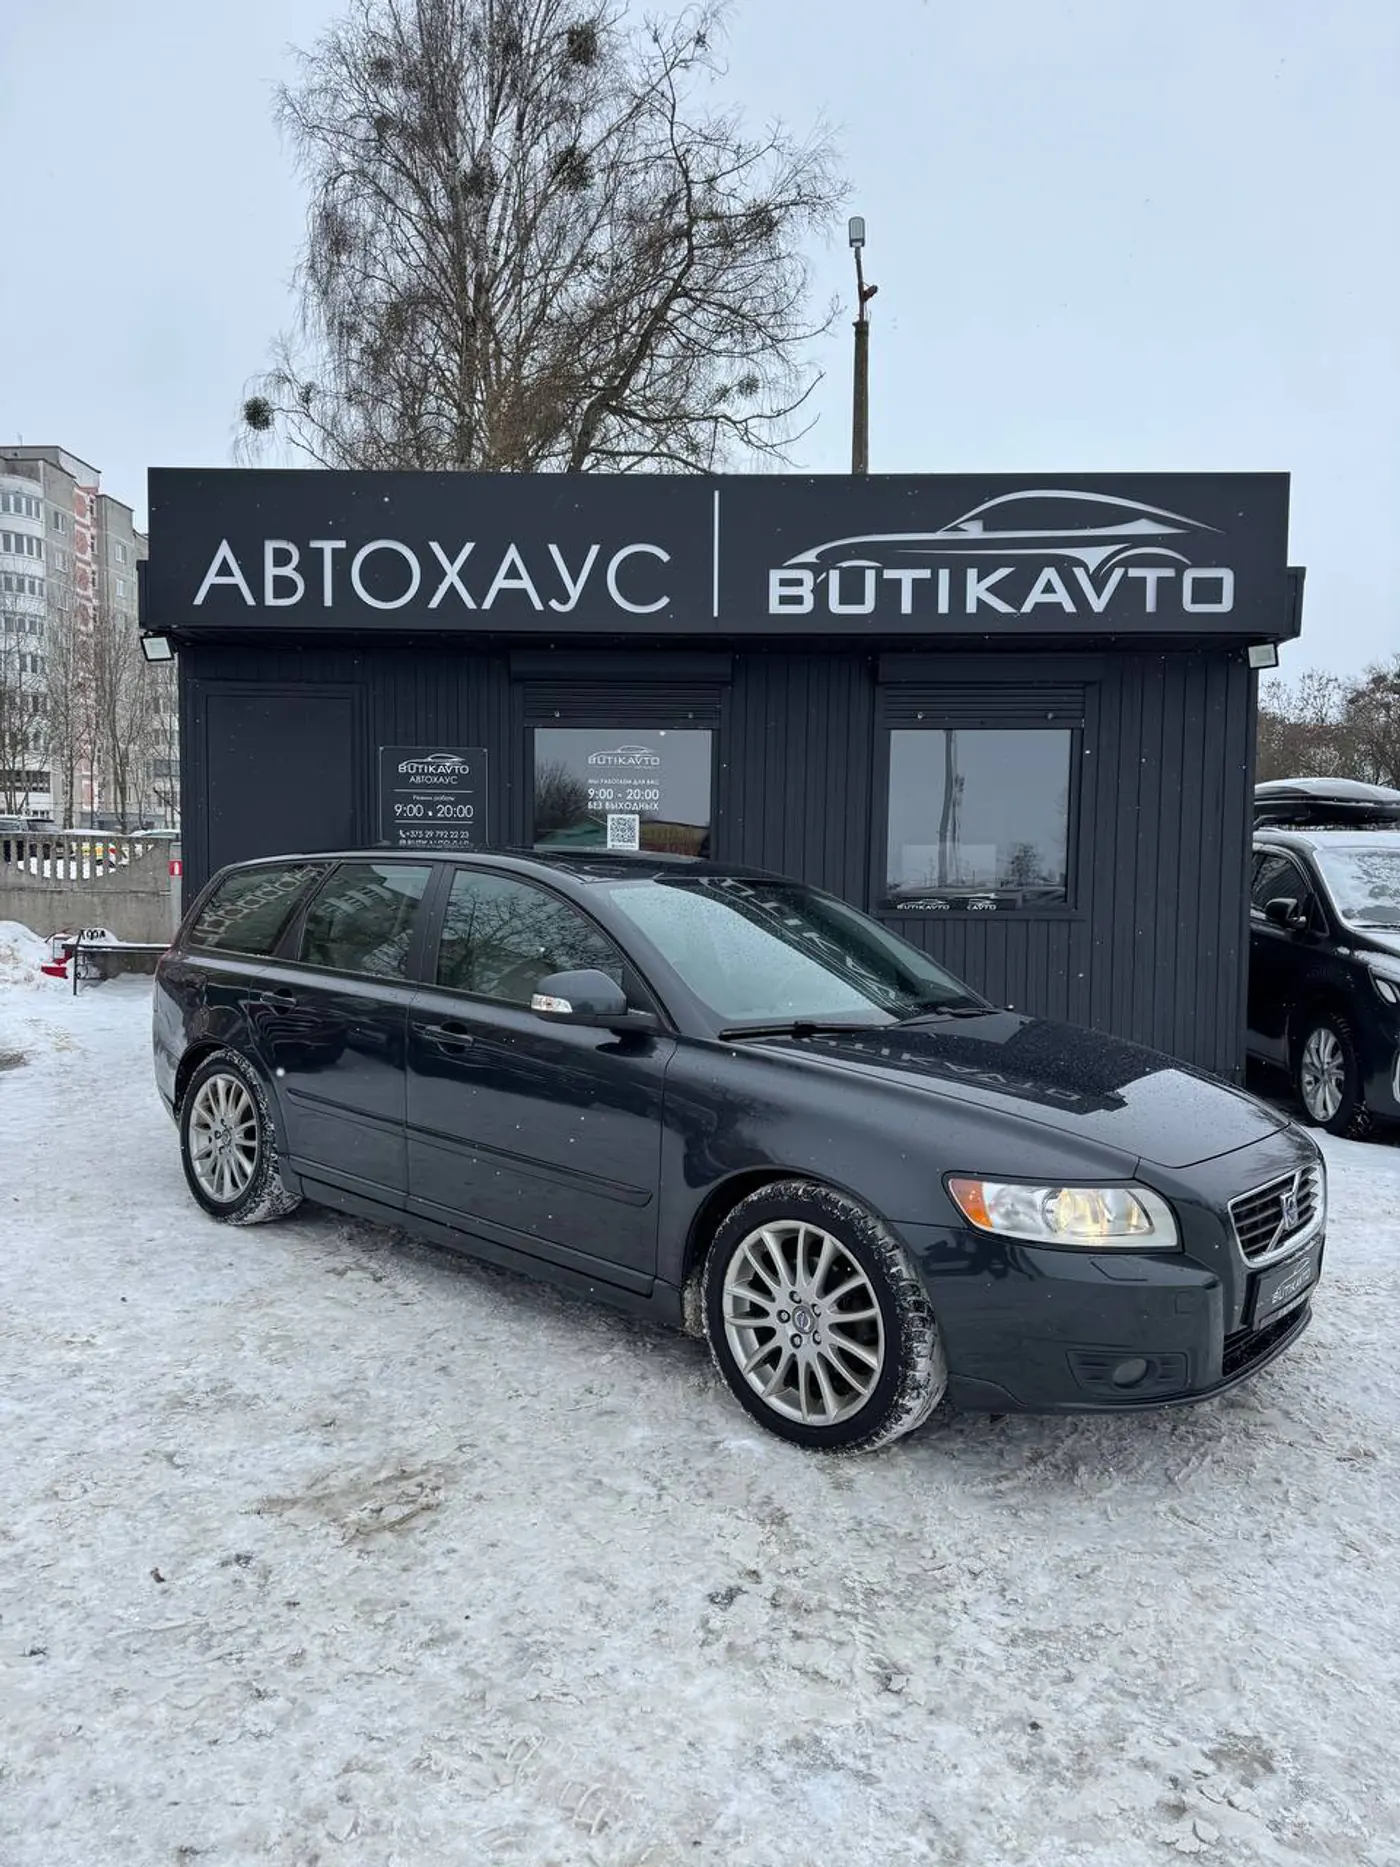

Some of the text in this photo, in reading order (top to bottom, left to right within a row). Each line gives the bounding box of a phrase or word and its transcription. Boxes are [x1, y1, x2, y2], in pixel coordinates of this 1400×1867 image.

[193, 538, 671, 613] АВТОХАУС
[768, 567, 1235, 614] BUTIKAVTO
[588, 755, 660, 766] BUTIKAVTO
[398, 763, 470, 774] BUTIKAVTO
[409, 775, 459, 784] АВТОХАУС
[587, 788, 614, 799] 9:00
[626, 788, 660, 800] 20:00
[394, 803, 424, 817] 9:00
[436, 804, 474, 818] 20:00
[587, 801, 659, 811] БЕЗ ВЫХОДНЫХ
[425, 830, 434, 838] 29
